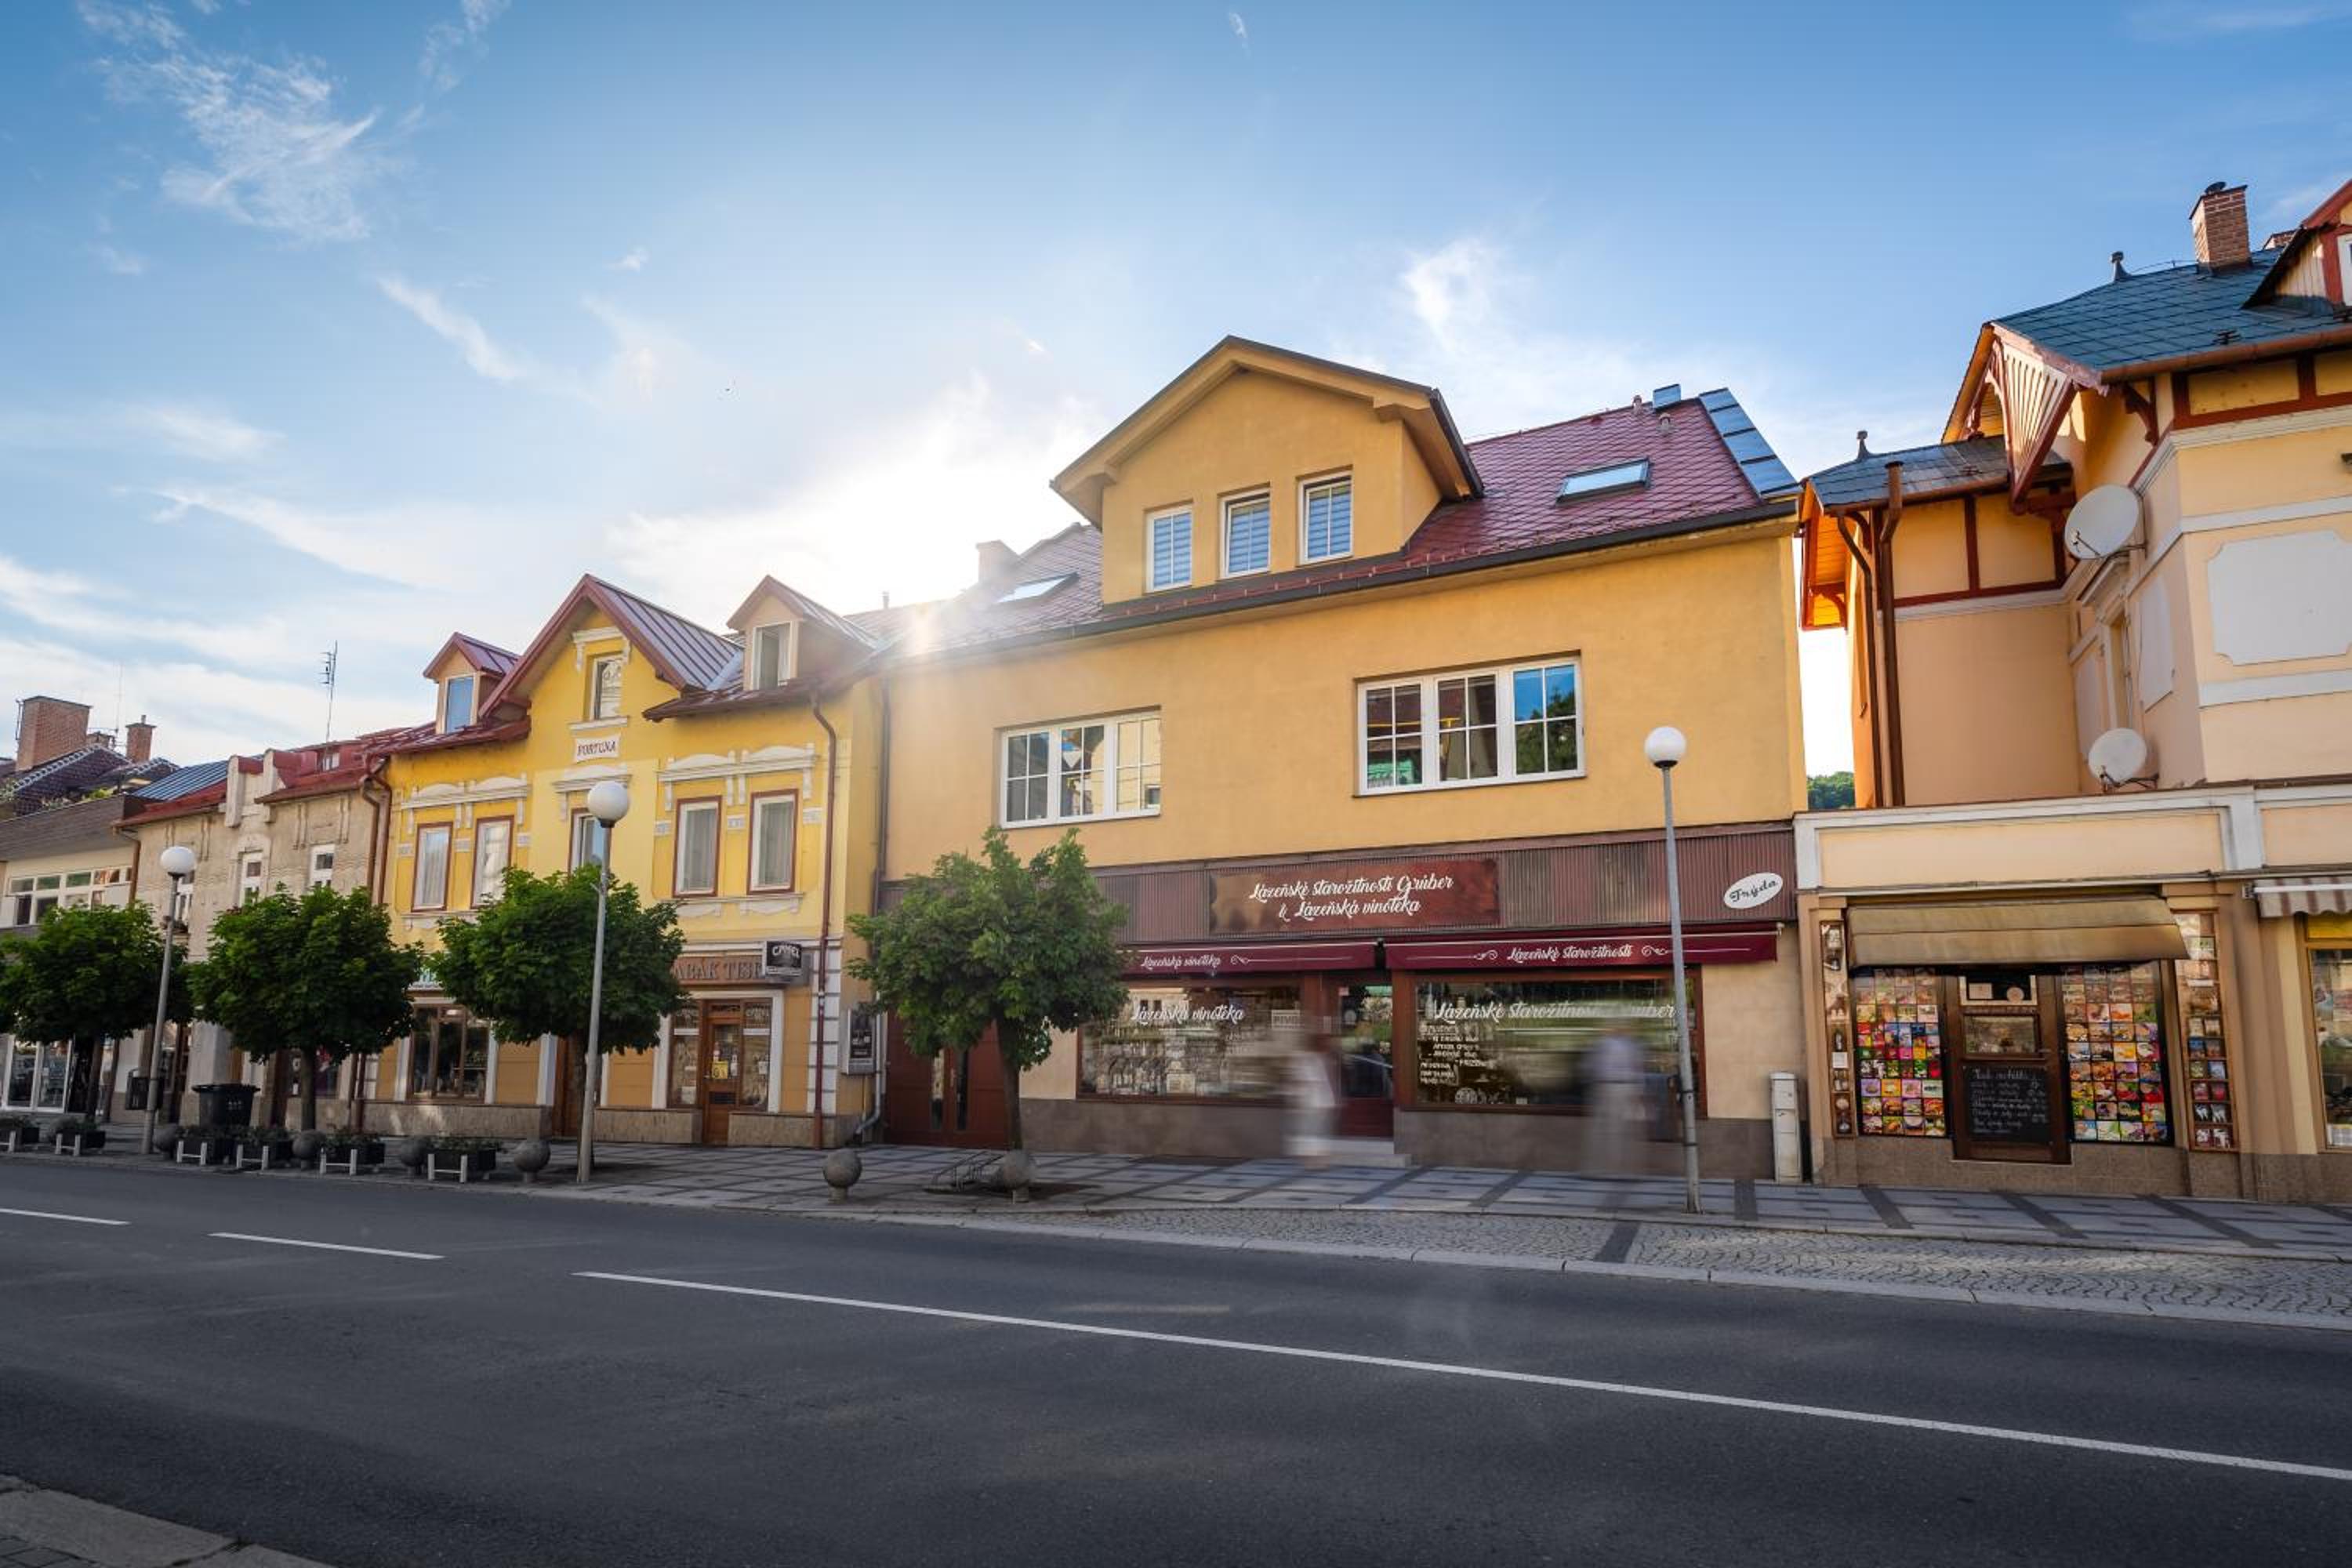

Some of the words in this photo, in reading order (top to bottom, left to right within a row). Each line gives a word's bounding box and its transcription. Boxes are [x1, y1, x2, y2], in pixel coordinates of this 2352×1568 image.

[578, 740, 615, 756] FORTUNA
[1312, 875, 1393, 897] starožitnosti
[1294, 898, 1359, 921] Lázeňská
[771, 944, 800, 959] CAMEL
